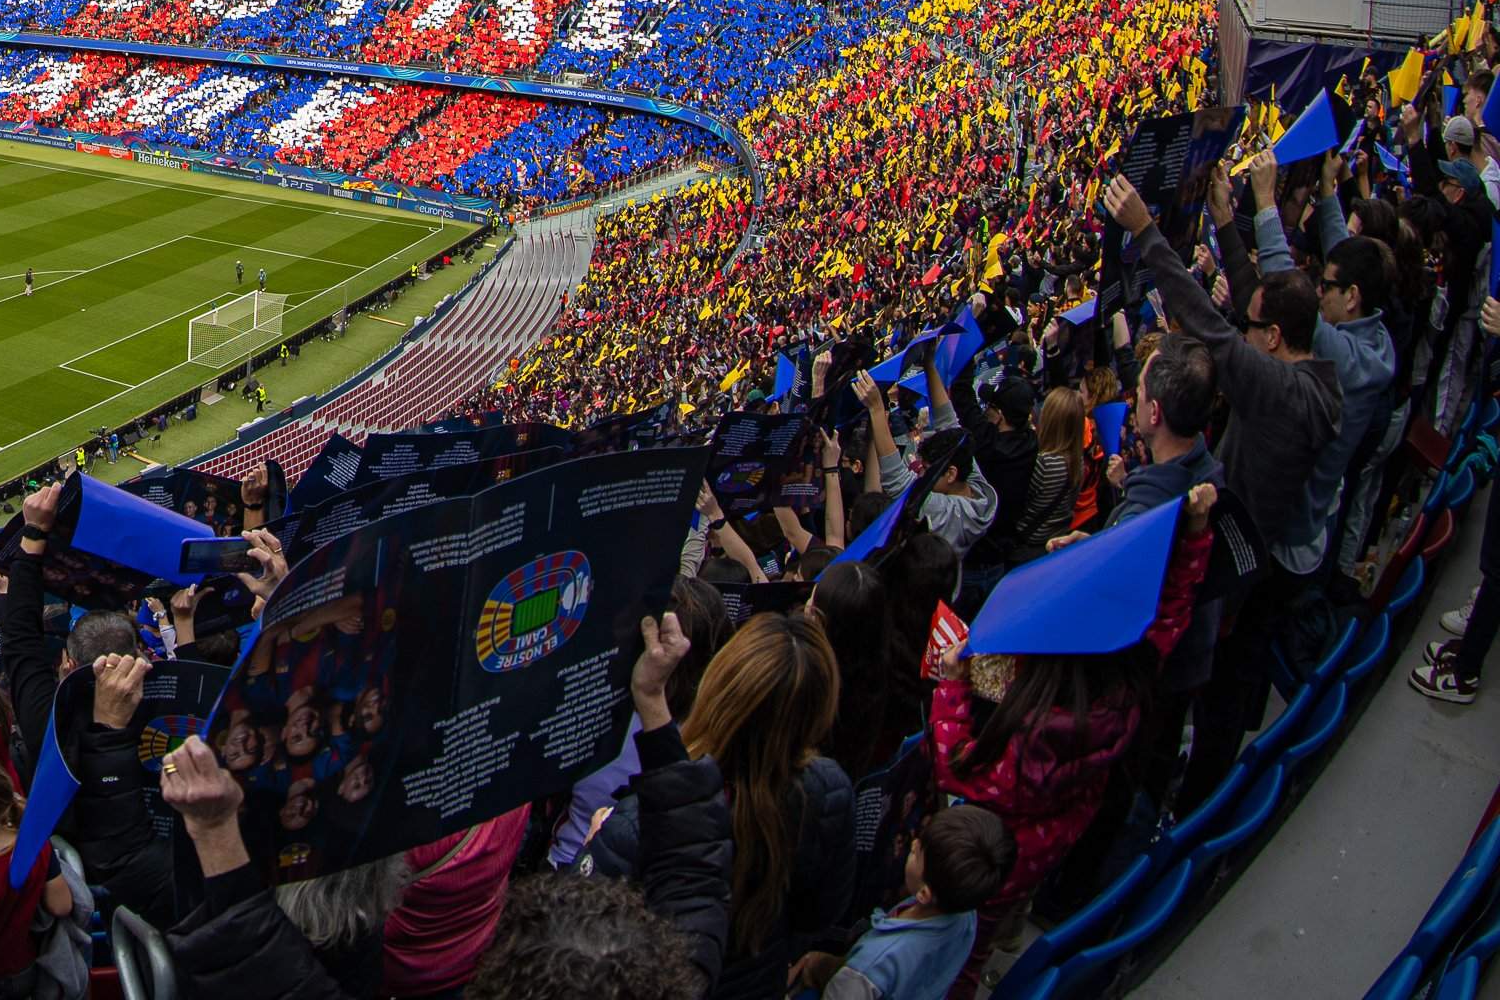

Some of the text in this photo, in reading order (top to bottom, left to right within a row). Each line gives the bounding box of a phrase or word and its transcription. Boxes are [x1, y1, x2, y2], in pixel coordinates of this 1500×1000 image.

[553, 89, 577, 97] WOMEN'S
[577, 91, 606, 100] CHAMPIONS
[607, 95, 624, 103] LEAGUE
[138, 152, 180, 169] Heineken
[290, 181, 314, 192] PS5
[419, 205, 454, 219] euronics
[495, 635, 558, 669] EL NOSTRE
